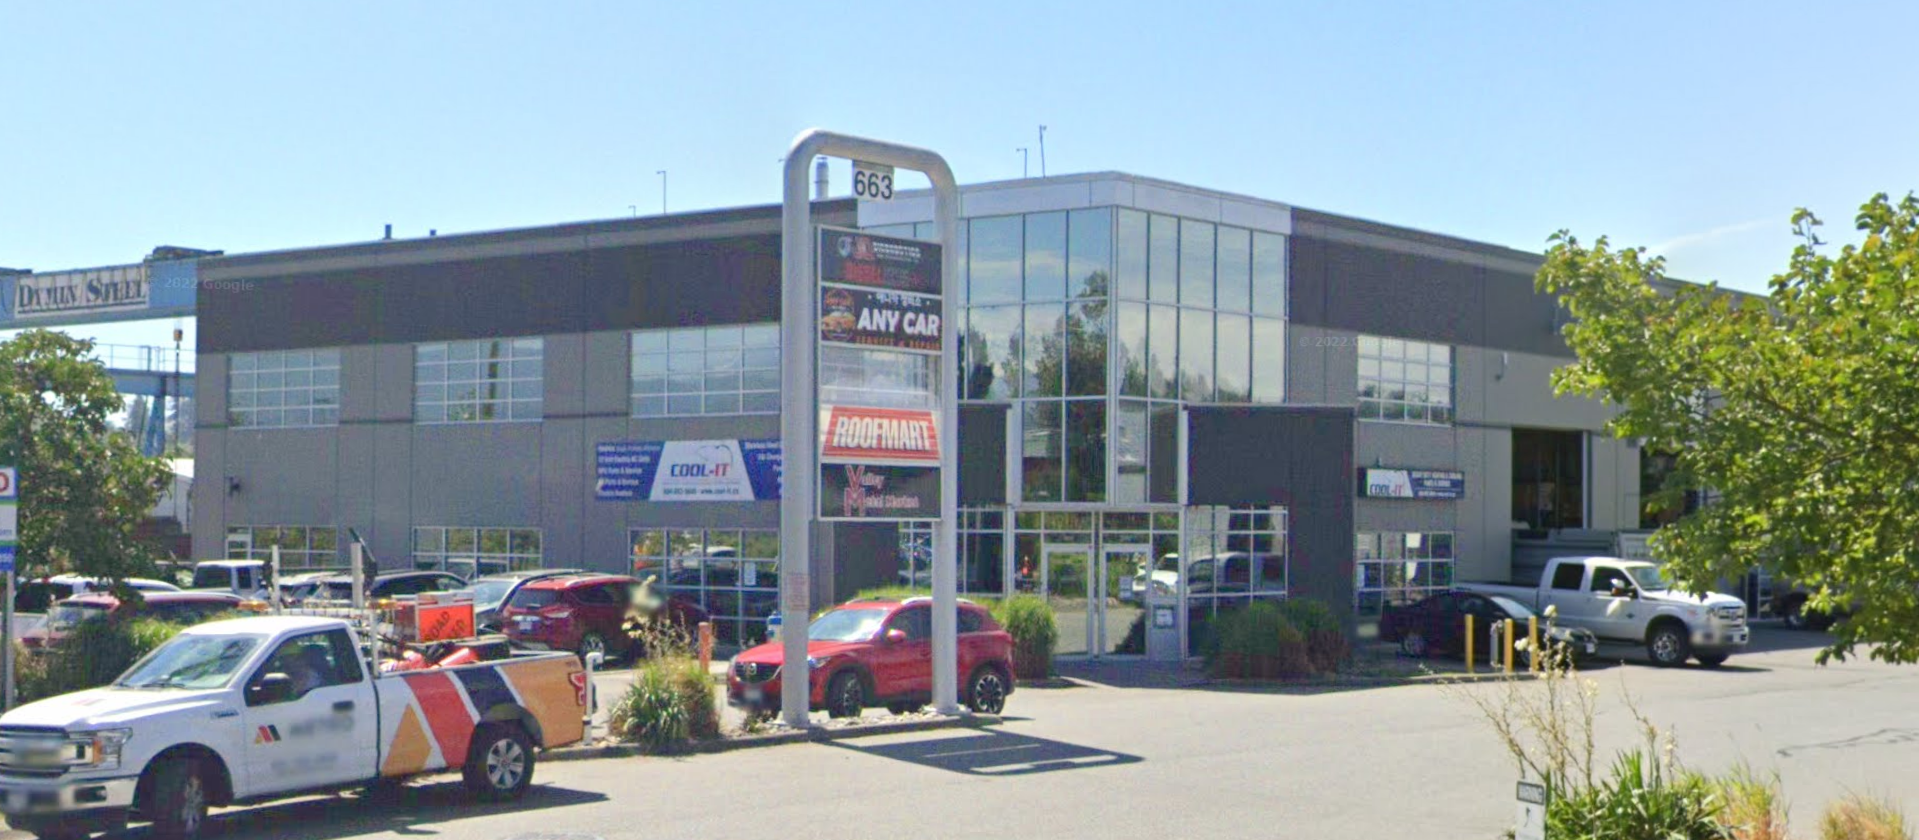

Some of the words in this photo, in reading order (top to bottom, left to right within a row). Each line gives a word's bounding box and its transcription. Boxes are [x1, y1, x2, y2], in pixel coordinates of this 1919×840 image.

[855, 170, 892, 199] 663
[86, 279, 147, 302] STEEL
[857, 307, 899, 333] ANY
[903, 312, 940, 336] CAR
[832, 415, 930, 451] ROOFMART
[671, 463, 729, 477] COOL-IT
[1370, 484, 1403, 496] COOL-IT
